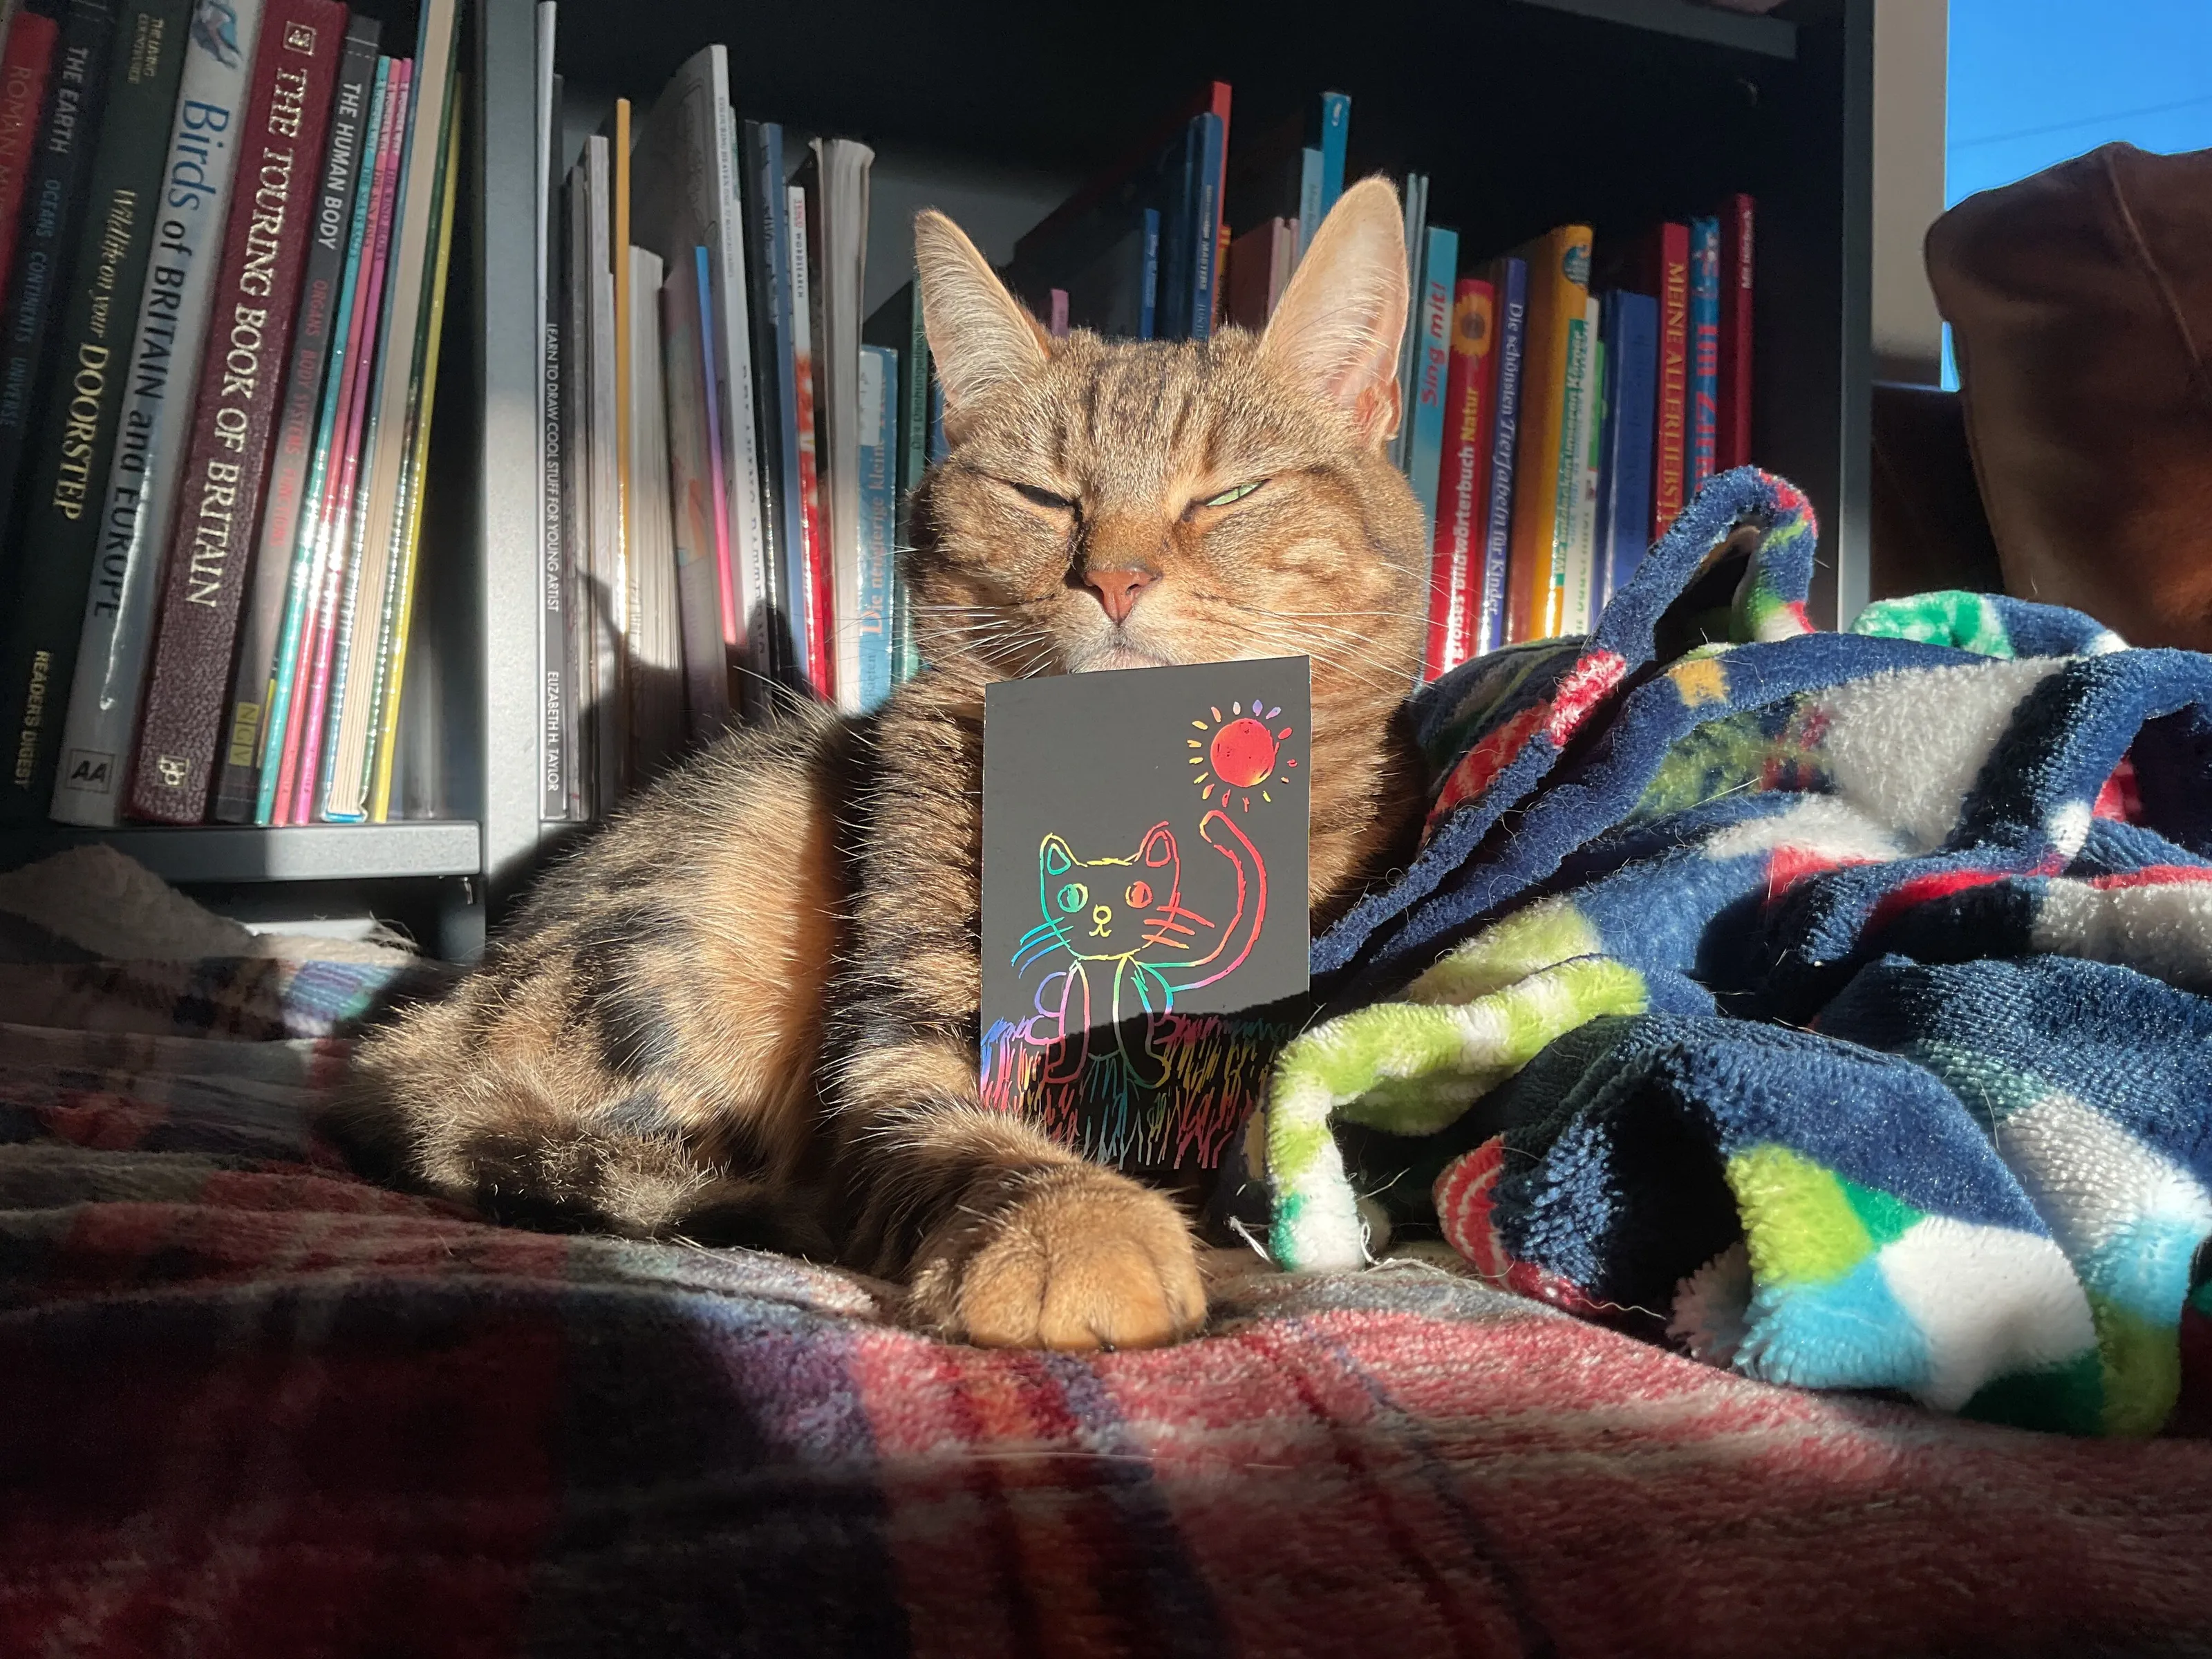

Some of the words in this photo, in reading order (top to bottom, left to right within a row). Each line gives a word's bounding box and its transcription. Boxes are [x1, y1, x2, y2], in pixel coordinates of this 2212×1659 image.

[62, 46, 89, 84] THE
[48, 88, 80, 153] EARTH
[268, 67, 308, 138] THE
[339, 82, 362, 118] THE
[168, 98, 230, 212] Birds
[326, 122, 355, 192] HUMAN
[36, 178, 61, 237] OCEANS
[102, 188, 137, 264] Wildlife
[239, 147, 294, 298] TOURING
[317, 196, 343, 251] BODY
[160, 220, 192, 256] of
[796, 232, 805, 299] WORDSEARCH
[97, 265, 115, 290] on
[1667, 262, 1685, 344] MEINE
[88, 289, 111, 339] your
[134, 265, 185, 400] BRITAIN
[304, 279, 328, 337] ORGANS
[1429, 281, 1447, 339] mit!
[1507, 301, 1524, 332] Die
[221, 303, 268, 400] BOOK
[297, 348, 318, 391] BODY
[547, 364, 559, 380] TO
[1421, 347, 1446, 408] Sing
[1501, 335, 1521, 415] schönsten
[54, 341, 110, 521] DOORSTEP
[214, 406, 250, 454] OF
[285, 393, 310, 455] SYSTEMS
[547, 383, 559, 421] DRAW
[1459, 386, 1479, 442] Natur
[120, 409, 153, 472] and
[546, 422, 559, 458] COOL
[547, 461, 559, 495] STUFF
[1492, 418, 1517, 527] Tierfabeln
[185, 460, 241, 608] BRITAIN
[269, 469, 297, 547] FUNCTIONS
[547, 495, 559, 522] FOR
[1453, 446, 1474, 591] Bildwörterbuch
[94, 485, 140, 619] EUROPE
[546, 523, 559, 573] YOUNG
[1491, 529, 1508, 554] für
[547, 574, 560, 612] ARTIST
[861, 595, 883, 635] Die
[1488, 559, 1506, 615] Kinder
[547, 671, 560, 730] ELIZABETH
[14, 731, 40, 787] DIGEST
[71, 760, 109, 783] AA
[547, 749, 560, 791] TAYLOR
